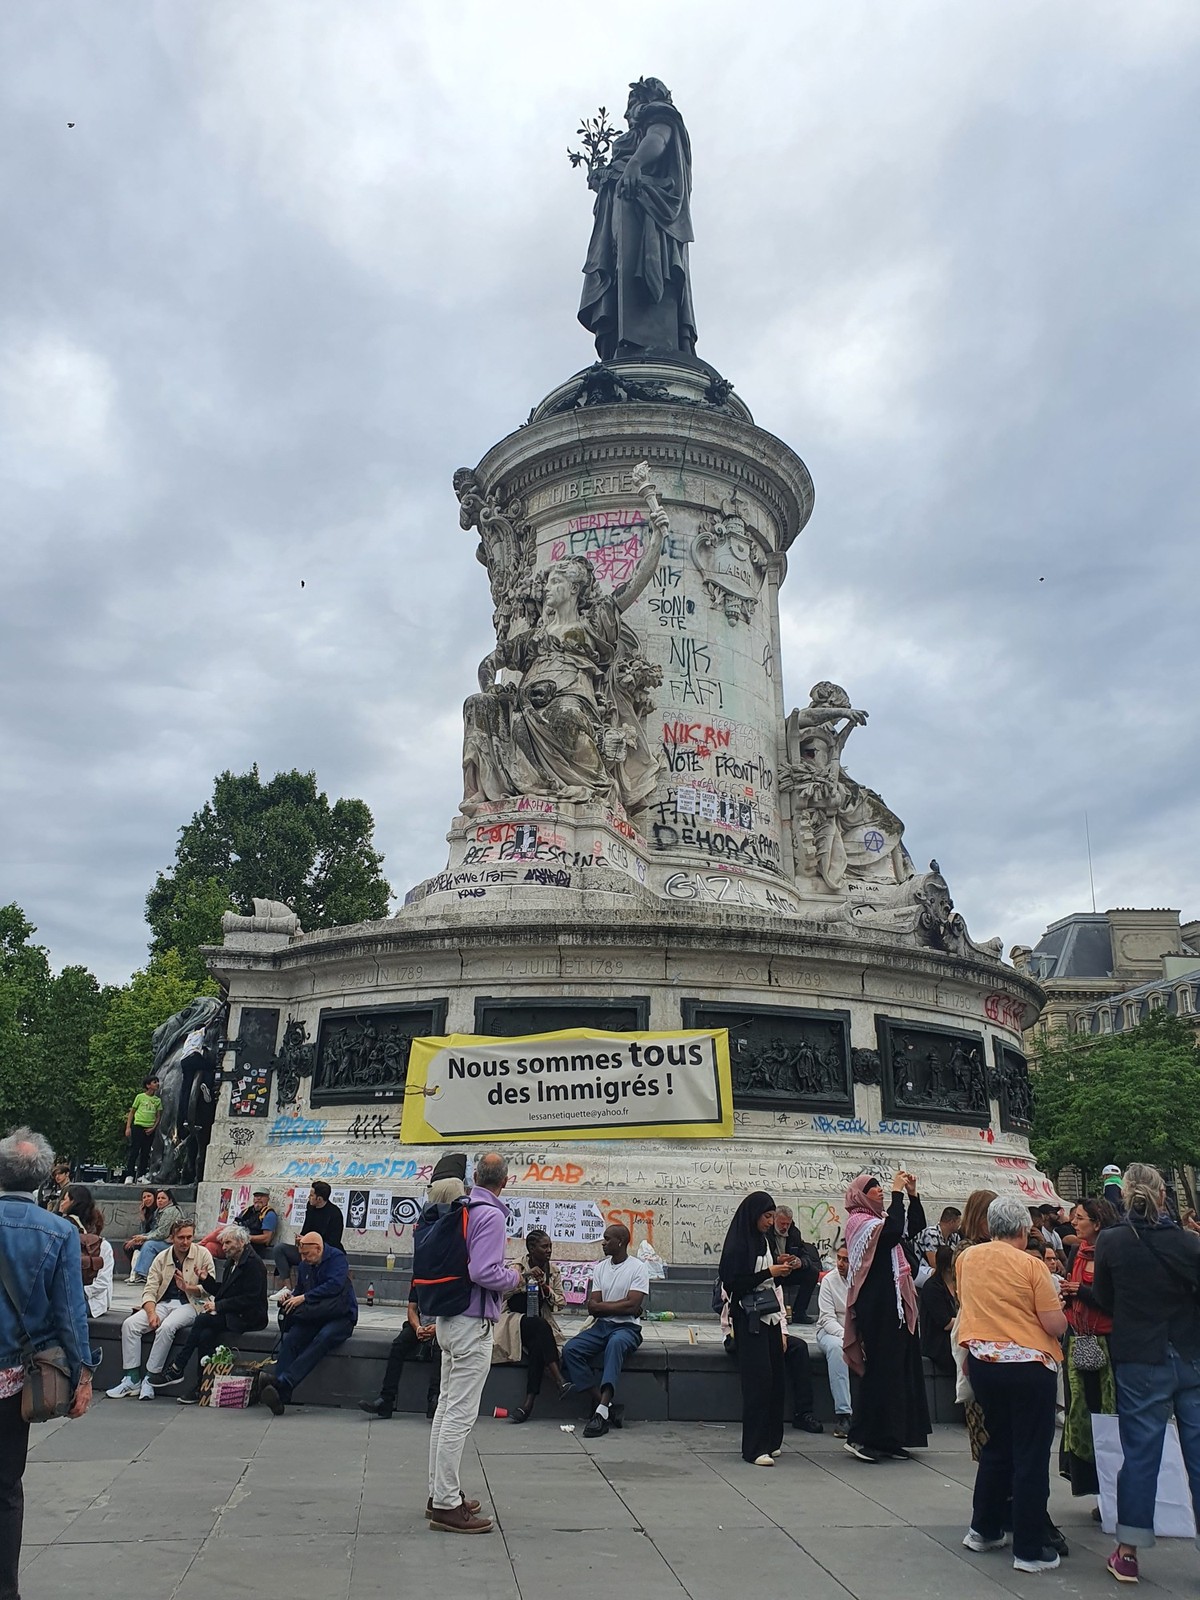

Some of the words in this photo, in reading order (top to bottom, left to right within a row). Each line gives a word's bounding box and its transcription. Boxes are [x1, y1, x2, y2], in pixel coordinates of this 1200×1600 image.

[663, 722, 702, 744] NIK
[704, 727, 731, 749] RN
[662, 743, 704, 773] VOTE
[715, 752, 759, 784] FRONT
[664, 872, 756, 906] GAZA
[396, 966, 423, 983] 1789
[590, 960, 623, 975] 1789
[716, 964, 725, 978] 4
[448, 1057, 509, 1080] Nous
[517, 1049, 622, 1076] sommes
[628, 1041, 703, 1068] tous
[487, 1081, 530, 1106] des
[537, 1072, 660, 1105] Immigrés
[666, 1072, 674, 1095] !
[528, 1107, 630, 1121] lessansetiquette@yahoo.fr
[733, 1111, 752, 1125] RE
[522, 1162, 585, 1184] ACAB
[626, 1169, 648, 1184] LA
[748, 1162, 768, 1177] LE
[528, 1200, 550, 1210] CASSER
[526, 1223, 547, 1233] BRISER
[581, 1219, 604, 1228] VIOLEURS
[553, 1229, 562, 1237] LE
[564, 1229, 575, 1238] RN
[703, 1241, 722, 1256] AC
